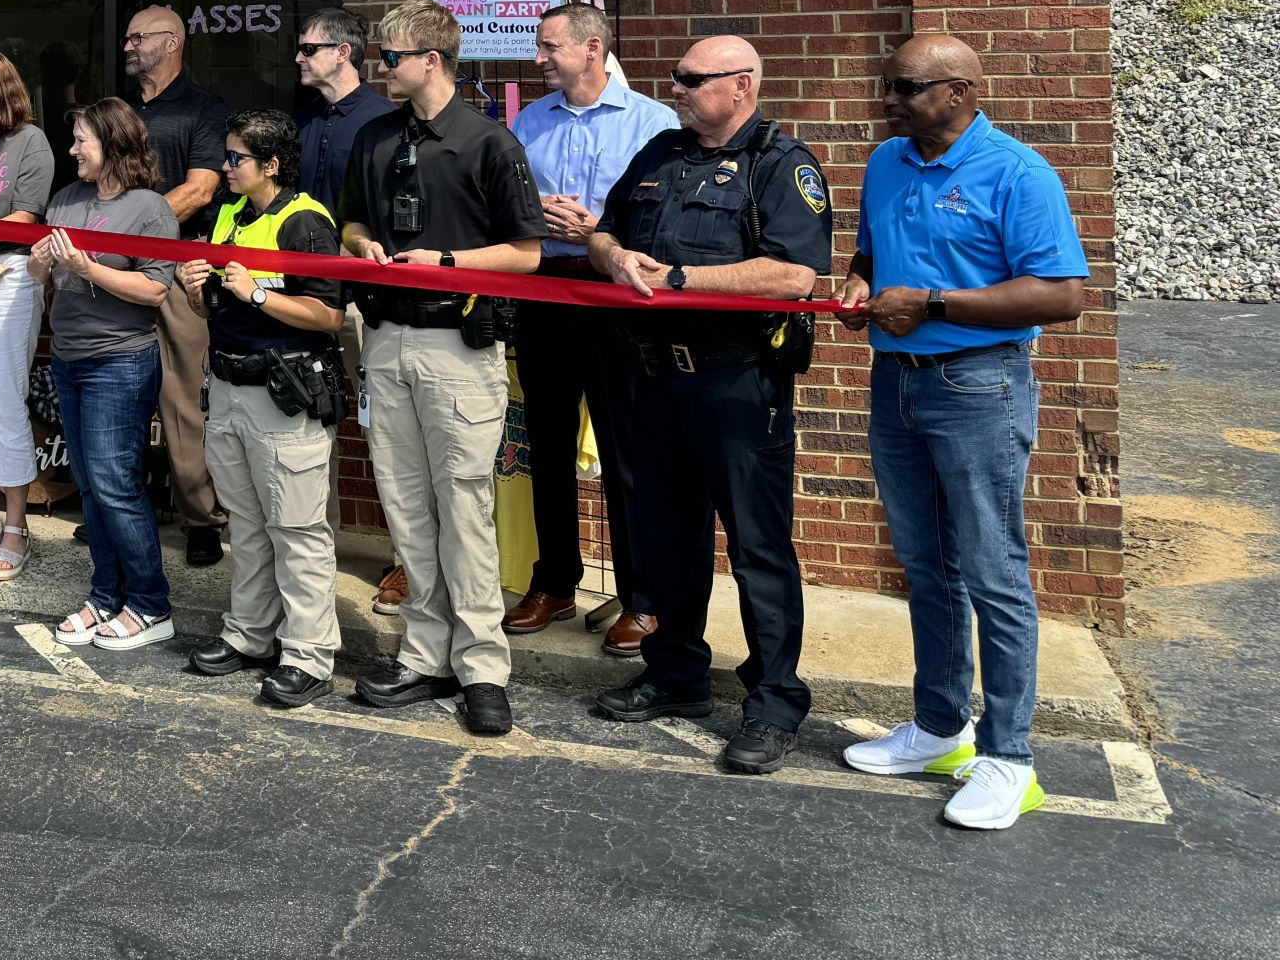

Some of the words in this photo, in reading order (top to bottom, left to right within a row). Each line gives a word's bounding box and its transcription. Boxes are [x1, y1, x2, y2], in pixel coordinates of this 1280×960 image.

[150, 4, 282, 35] ASSES
[459, 22, 484, 34] ood
[487, 22, 538, 34] Cutou
[519, 46, 538, 54] frien
